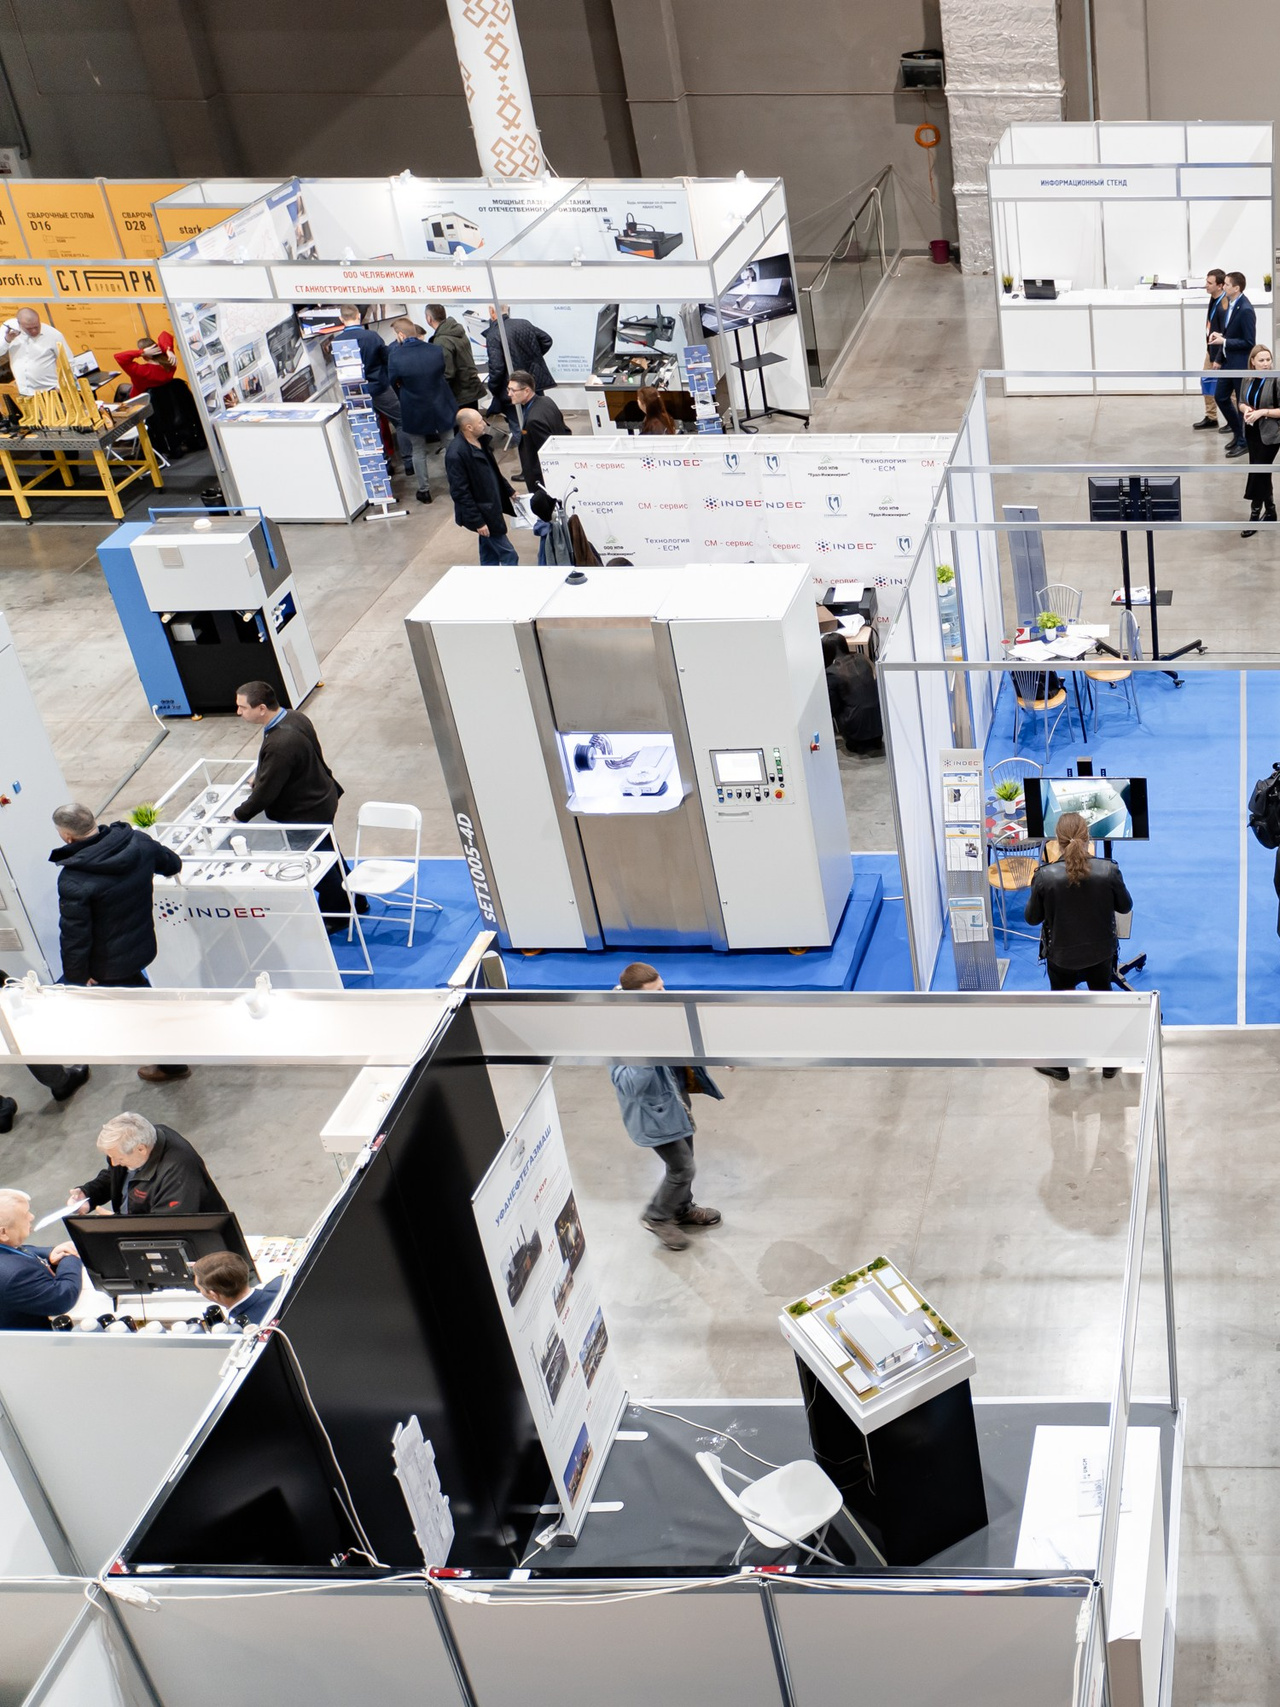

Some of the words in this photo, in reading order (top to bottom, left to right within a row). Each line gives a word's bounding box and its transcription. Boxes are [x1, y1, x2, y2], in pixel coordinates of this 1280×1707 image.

[1040, 177, 1105, 187] ИНФОРМАЦИОННЫЙ
[1107, 179, 1128, 187] СТЕНД
[30, 221, 52, 231] D16
[125, 221, 147, 231] D28
[343, 271, 358, 279] ООО
[360, 270, 415, 279] ЧЕЛЯБИНСКИЙ
[295, 285, 385, 293] СТАНКОСТРОИТЕЛЬНЫЙ
[391, 285, 417, 294] ЗАВОД
[427, 285, 471, 293] ЧЕЛЯБИНСК
[456, 812, 497, 923] SET1005-4D
[495, 1124, 552, 1227] УФАНЕФТЕГАЗМАШ
